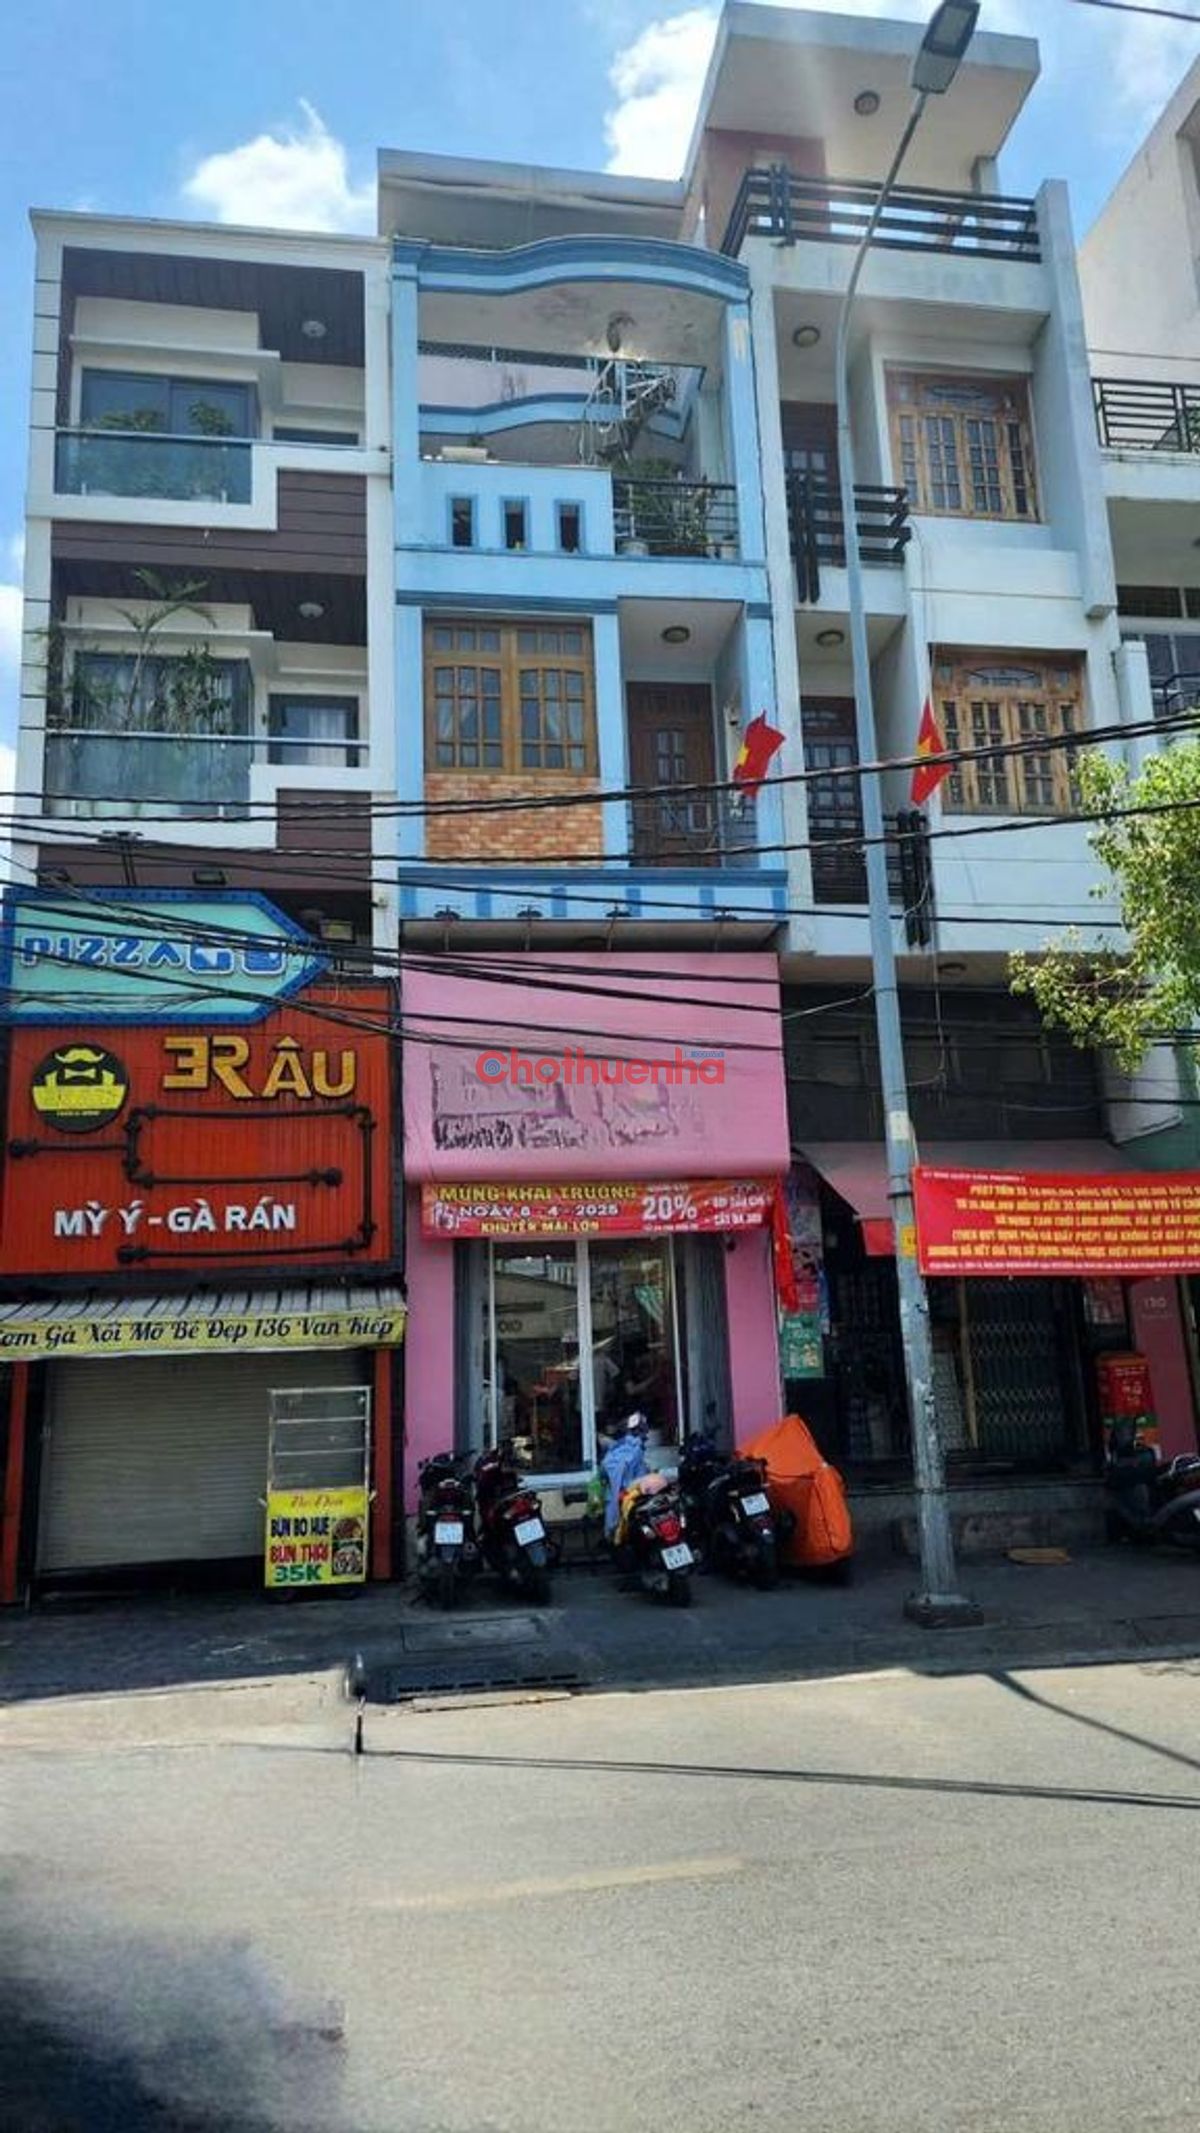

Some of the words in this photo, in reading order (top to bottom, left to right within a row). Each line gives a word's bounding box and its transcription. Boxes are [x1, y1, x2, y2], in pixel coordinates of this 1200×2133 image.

[225, 1196, 296, 1231] RÁN
[642, 1194, 698, 1220] 20%
[254, 1318, 291, 1337] 136
[274, 1565, 322, 1582] 35K
